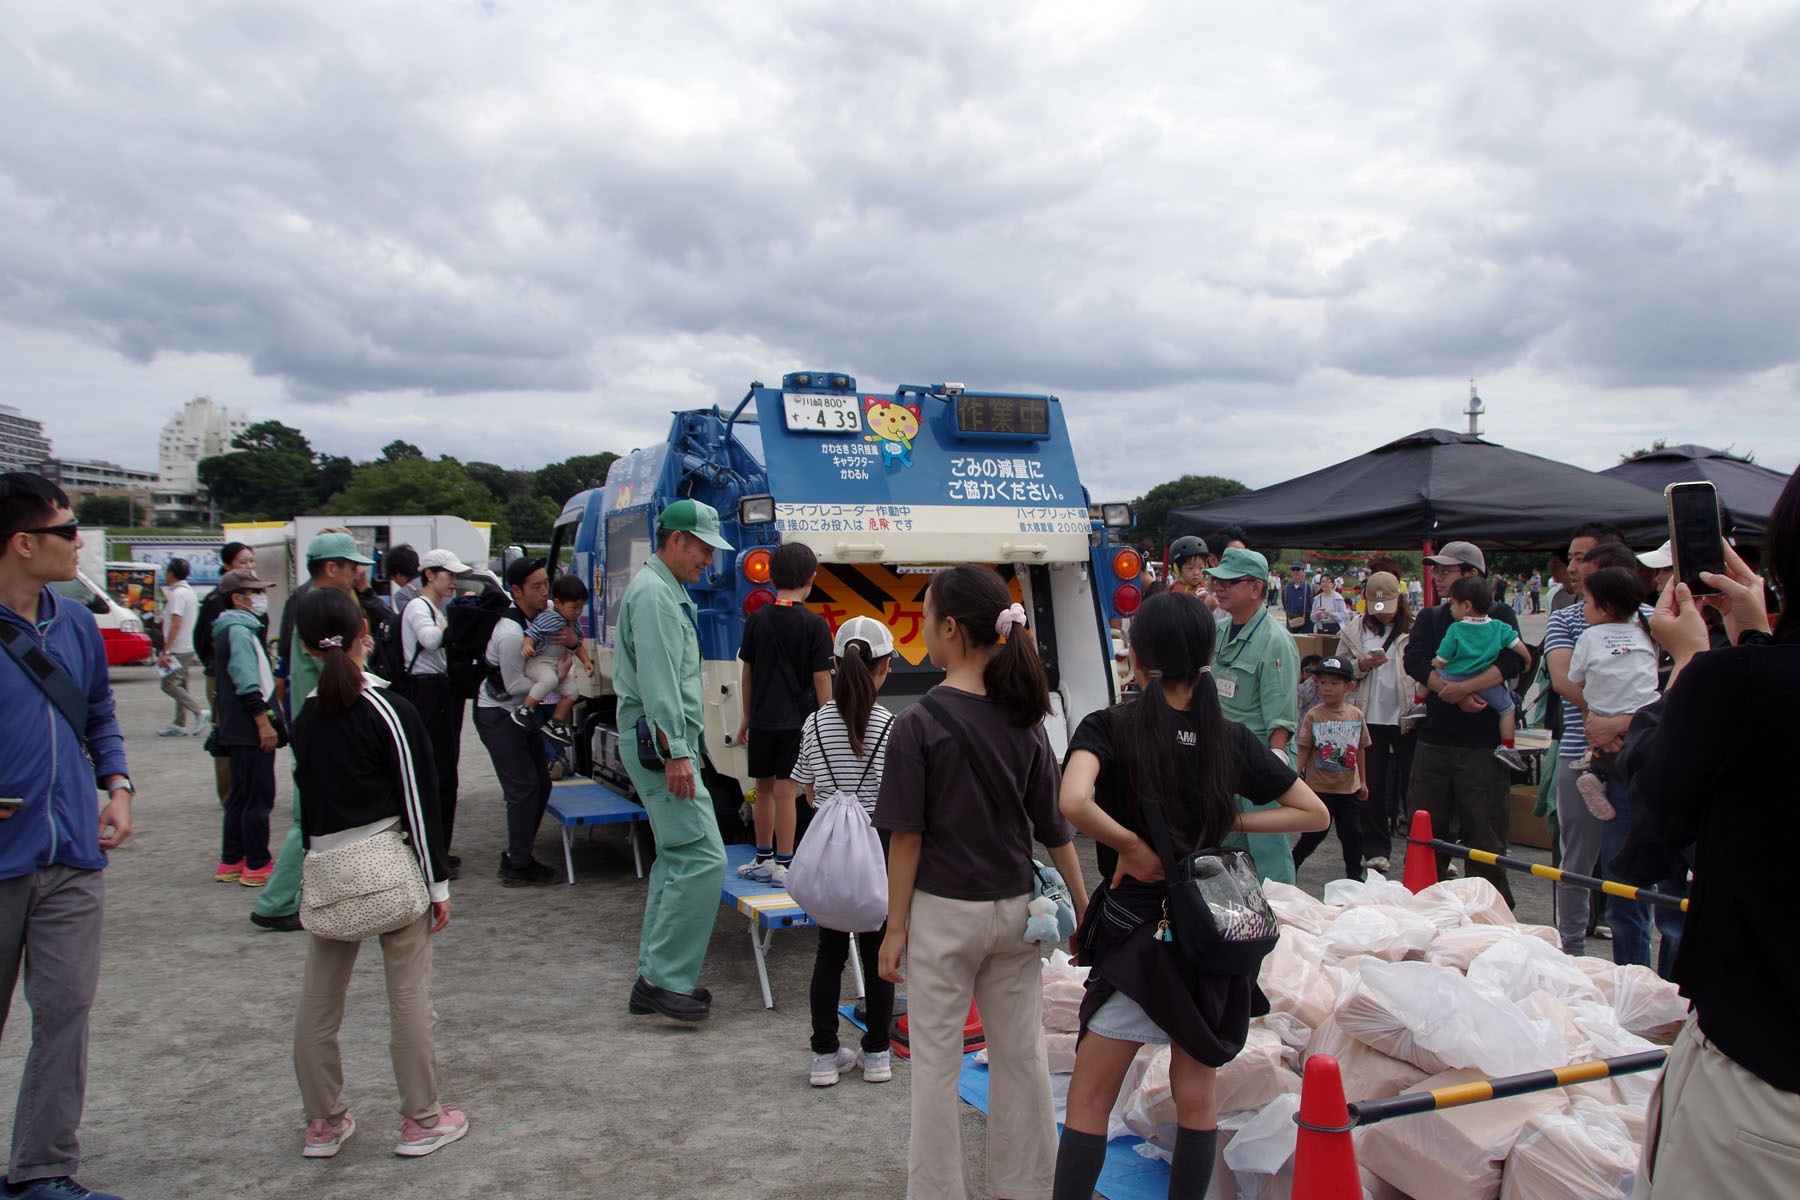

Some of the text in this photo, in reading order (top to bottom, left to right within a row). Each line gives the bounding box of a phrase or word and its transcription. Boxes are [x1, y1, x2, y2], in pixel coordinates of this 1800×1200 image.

[958, 397, 1046, 432] 作業中
[832, 456, 874, 467] キャラクター
[951, 457, 1044, 479] ごみの減量に
[840, 468, 869, 480] かわるん
[948, 479, 1065, 501] ご協力ください。
[868, 517, 890, 531] 危険
[893, 519, 913, 531] です
